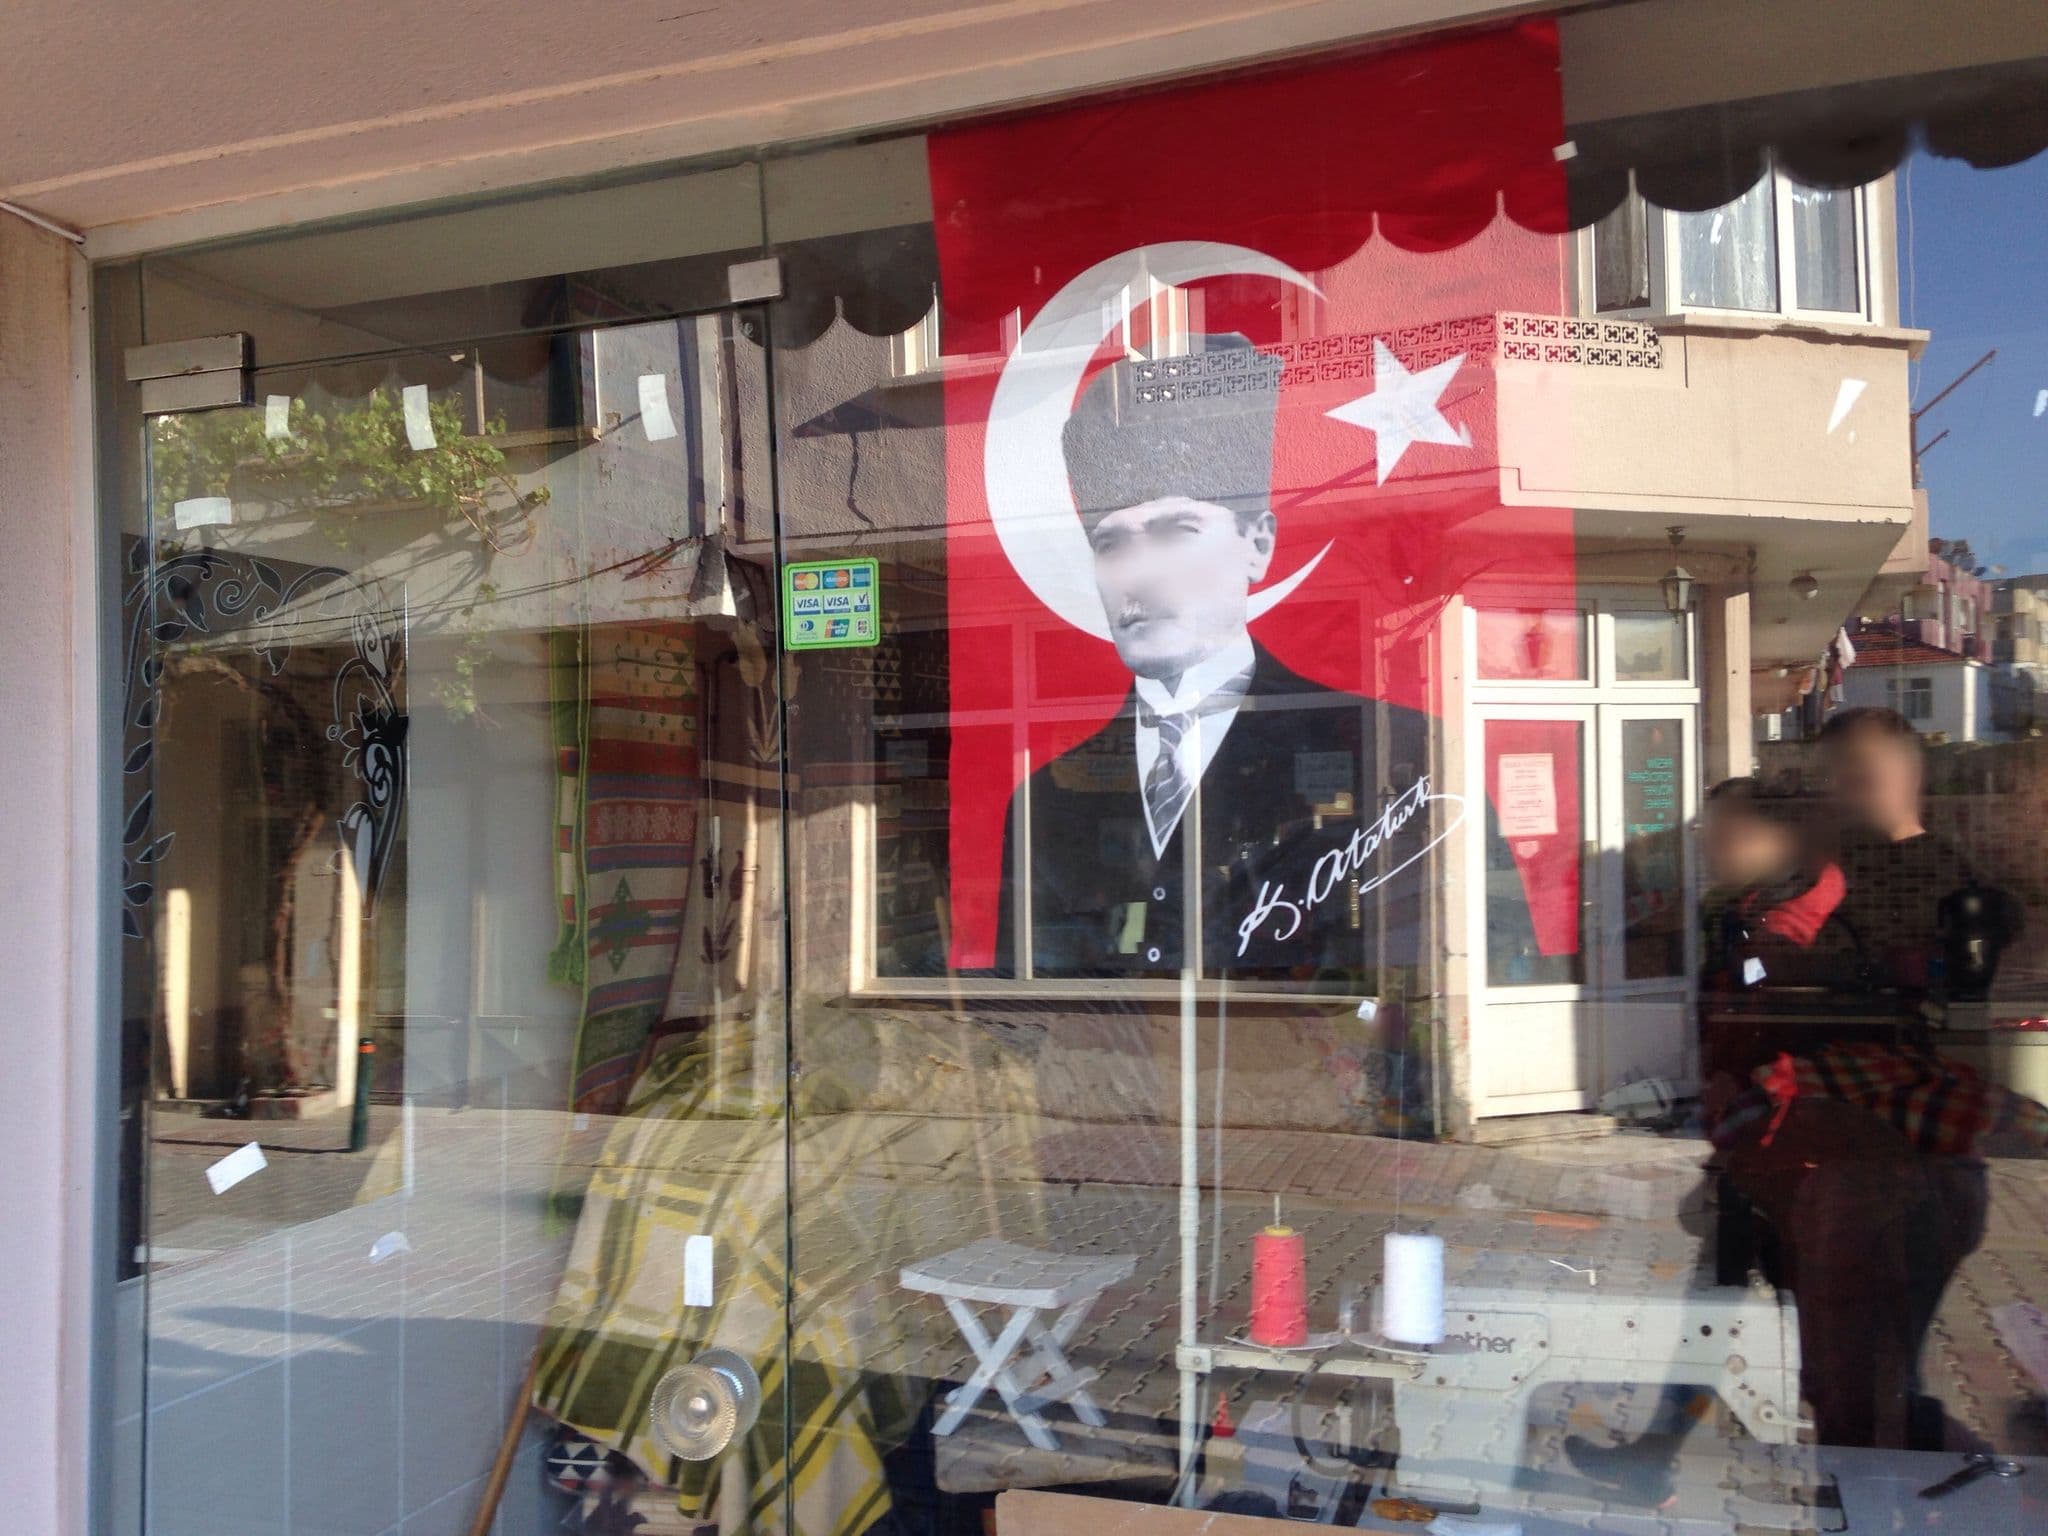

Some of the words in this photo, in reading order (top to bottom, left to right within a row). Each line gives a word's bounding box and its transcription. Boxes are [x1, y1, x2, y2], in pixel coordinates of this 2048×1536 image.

[797, 598, 819, 609] VISA
[826, 597, 849, 607] VISA
[1444, 1331, 1516, 1354] ther
